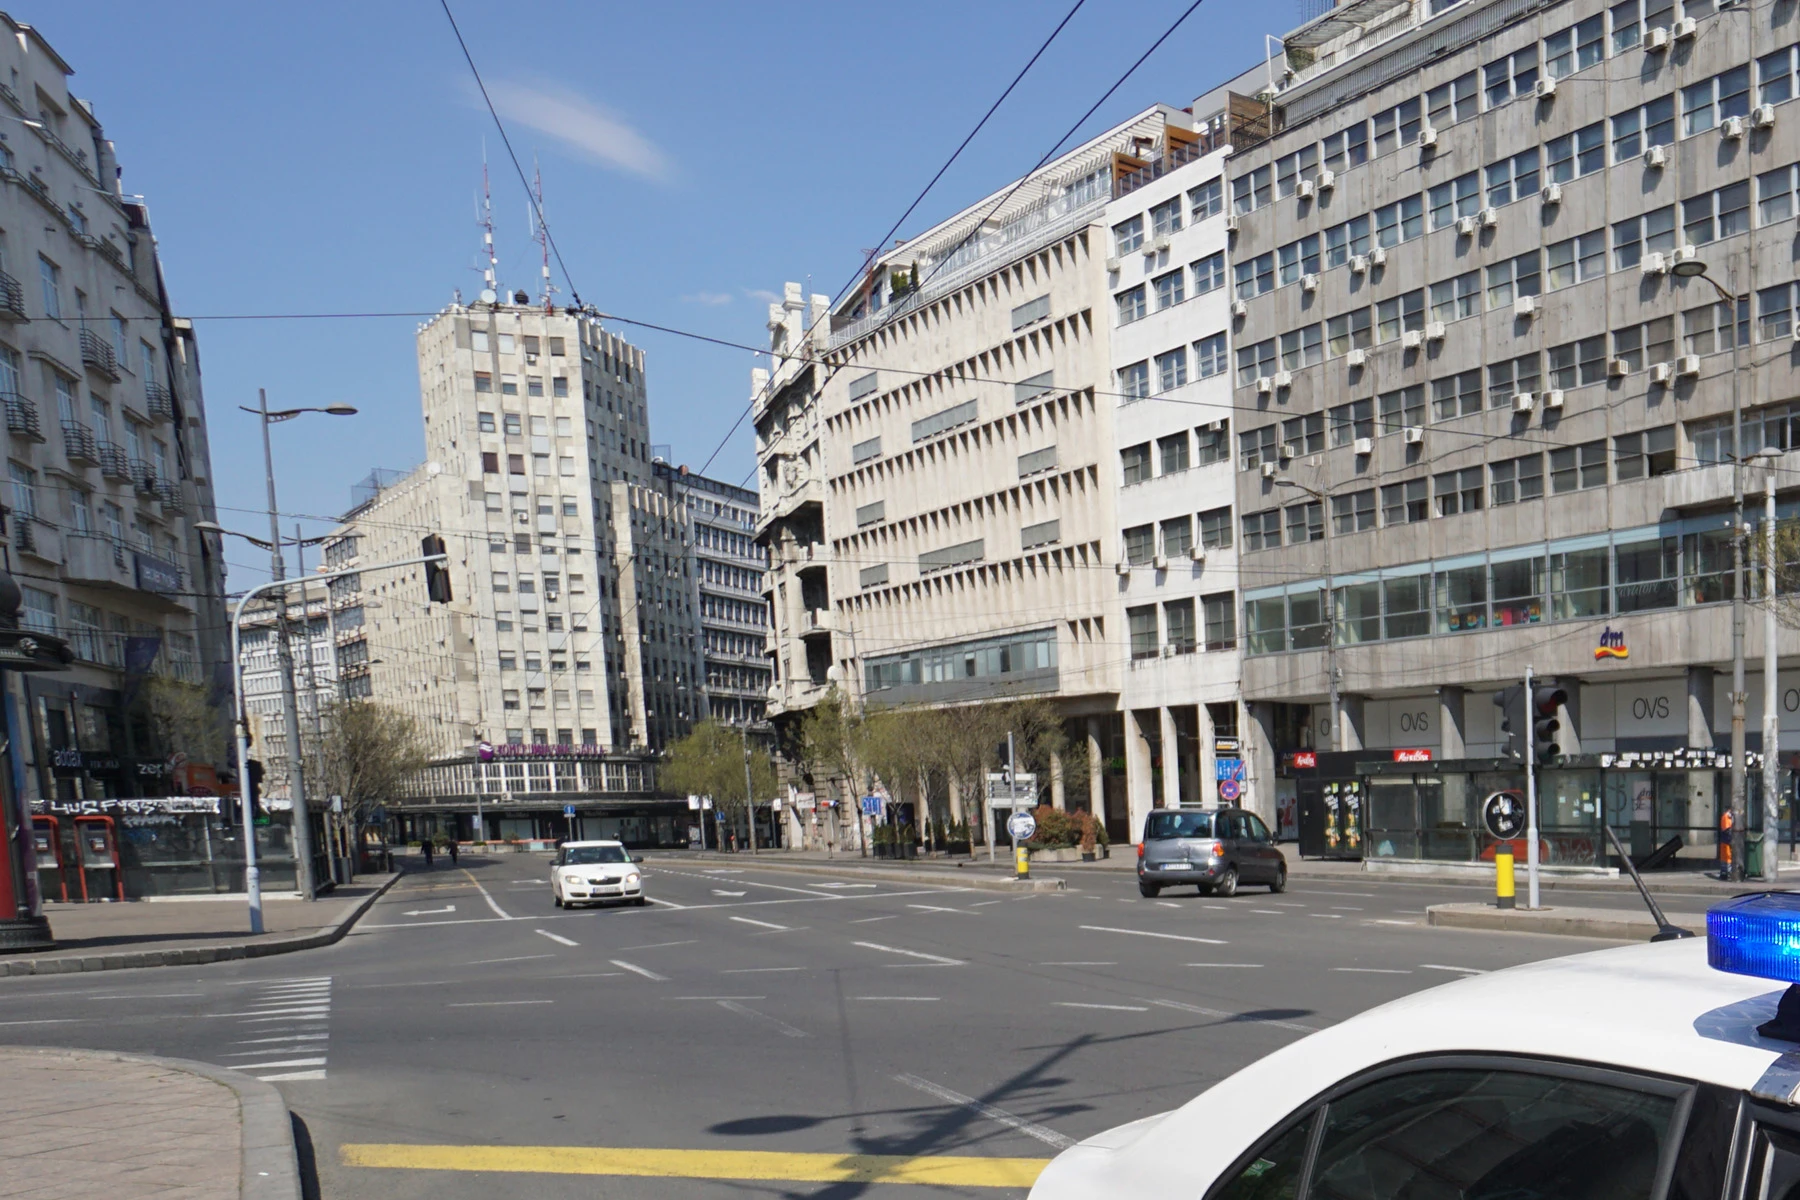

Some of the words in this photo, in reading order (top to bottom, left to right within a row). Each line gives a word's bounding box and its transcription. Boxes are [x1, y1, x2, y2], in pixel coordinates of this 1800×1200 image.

[1600, 626, 1624, 648] dm
[1633, 696, 1670, 720] OVS
[1400, 711, 1429, 733] OVS
